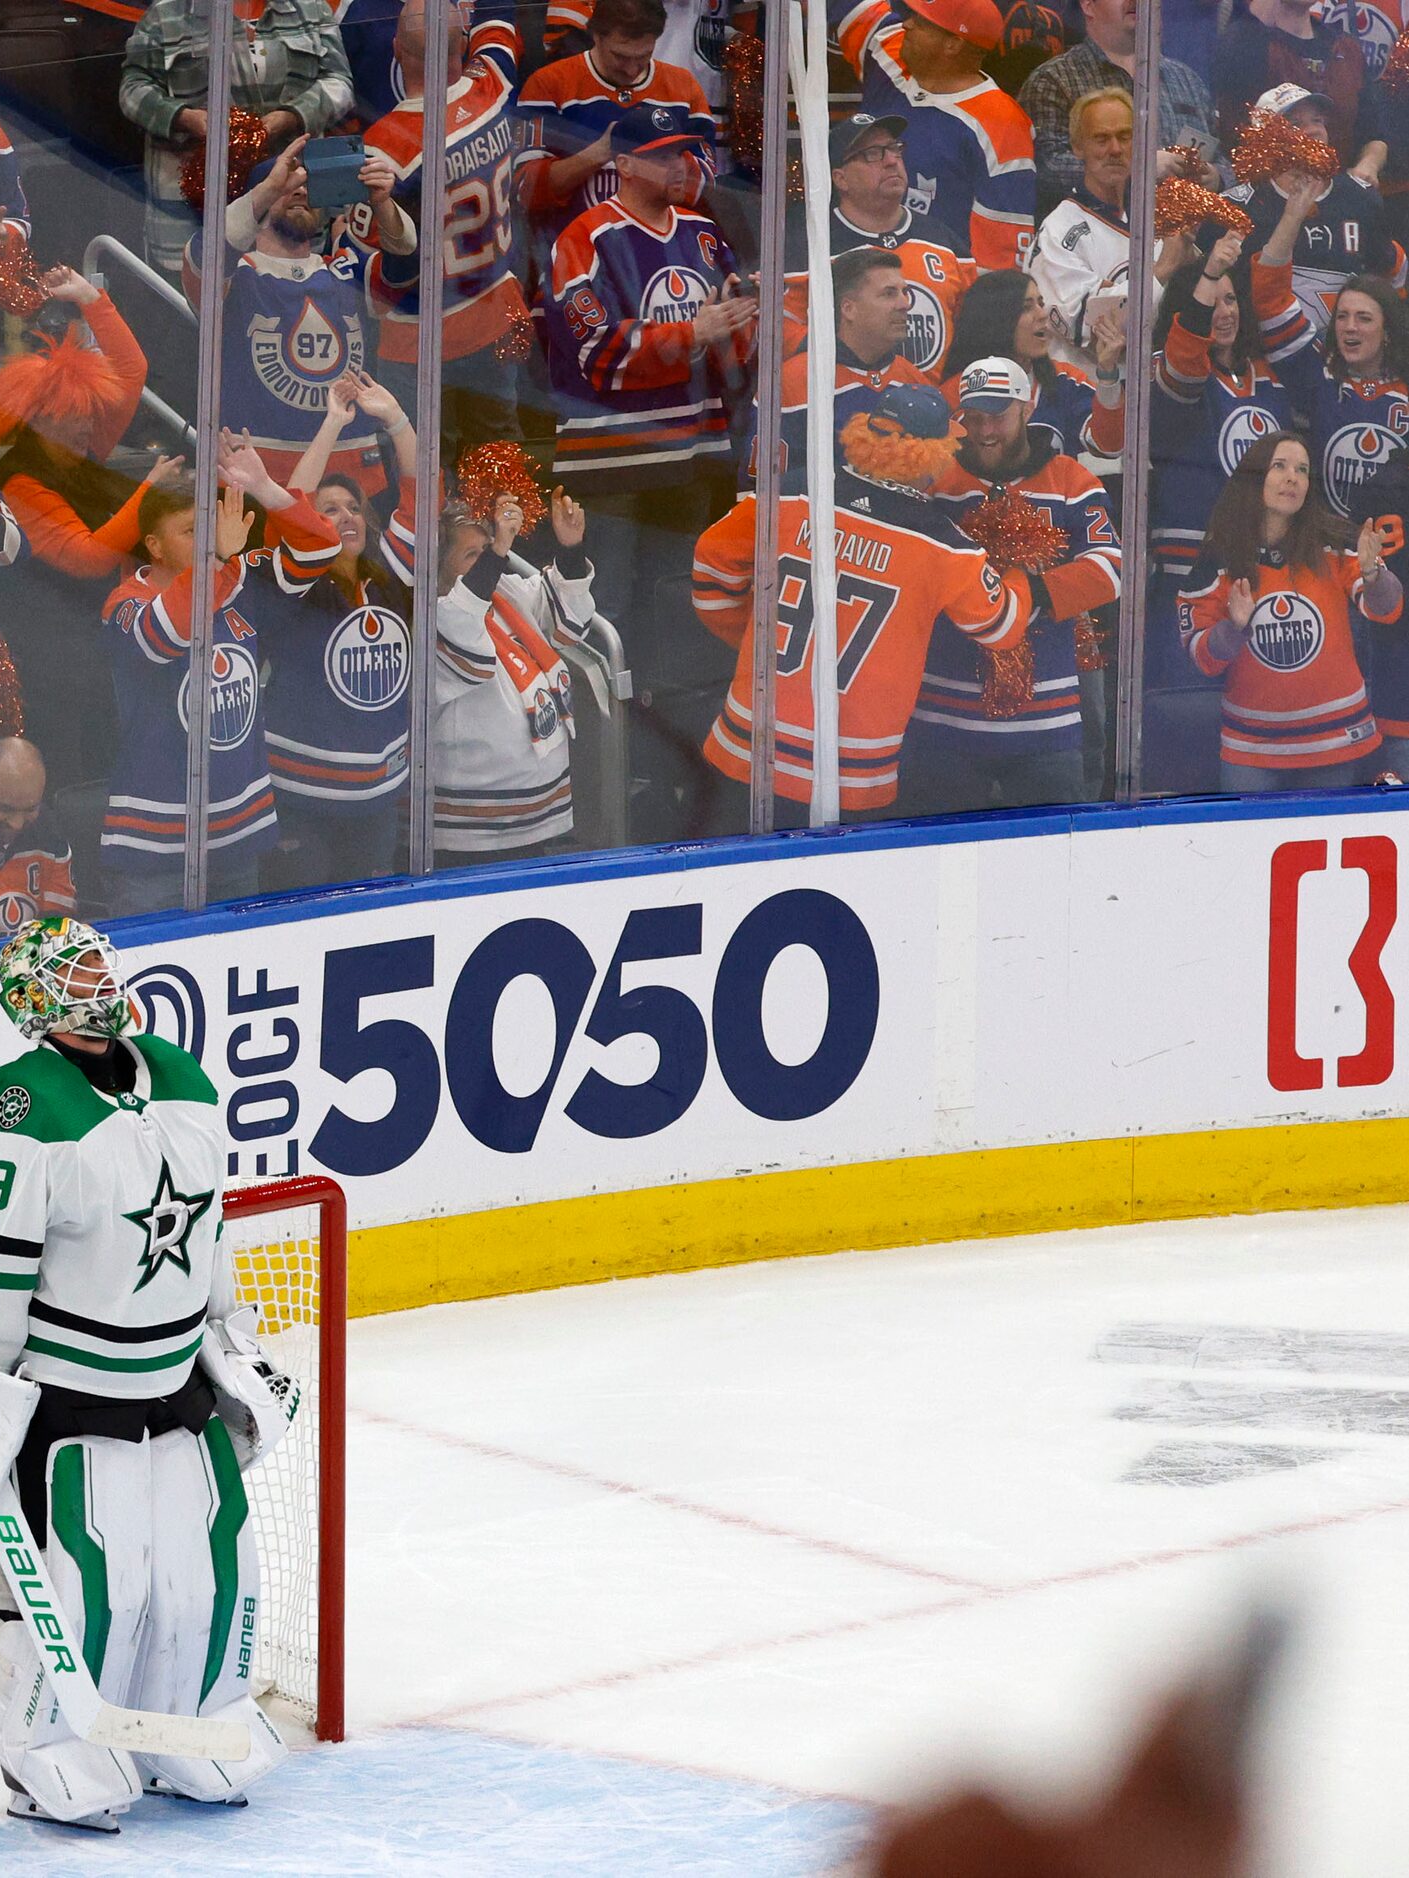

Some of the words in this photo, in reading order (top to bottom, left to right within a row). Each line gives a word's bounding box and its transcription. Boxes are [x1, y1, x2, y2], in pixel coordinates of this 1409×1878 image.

[697, 231, 718, 270] C
[923, 252, 945, 282] C
[564, 288, 607, 339] 99
[653, 301, 704, 323] OILER
[298, 333, 332, 359] 97
[795, 519, 893, 573] MDAVID
[224, 608, 256, 642] A
[776, 553, 901, 695] 97
[1255, 619, 1313, 644] OILERS
[339, 646, 403, 674] OILERS
[227, 966, 300, 1178] EOCF
